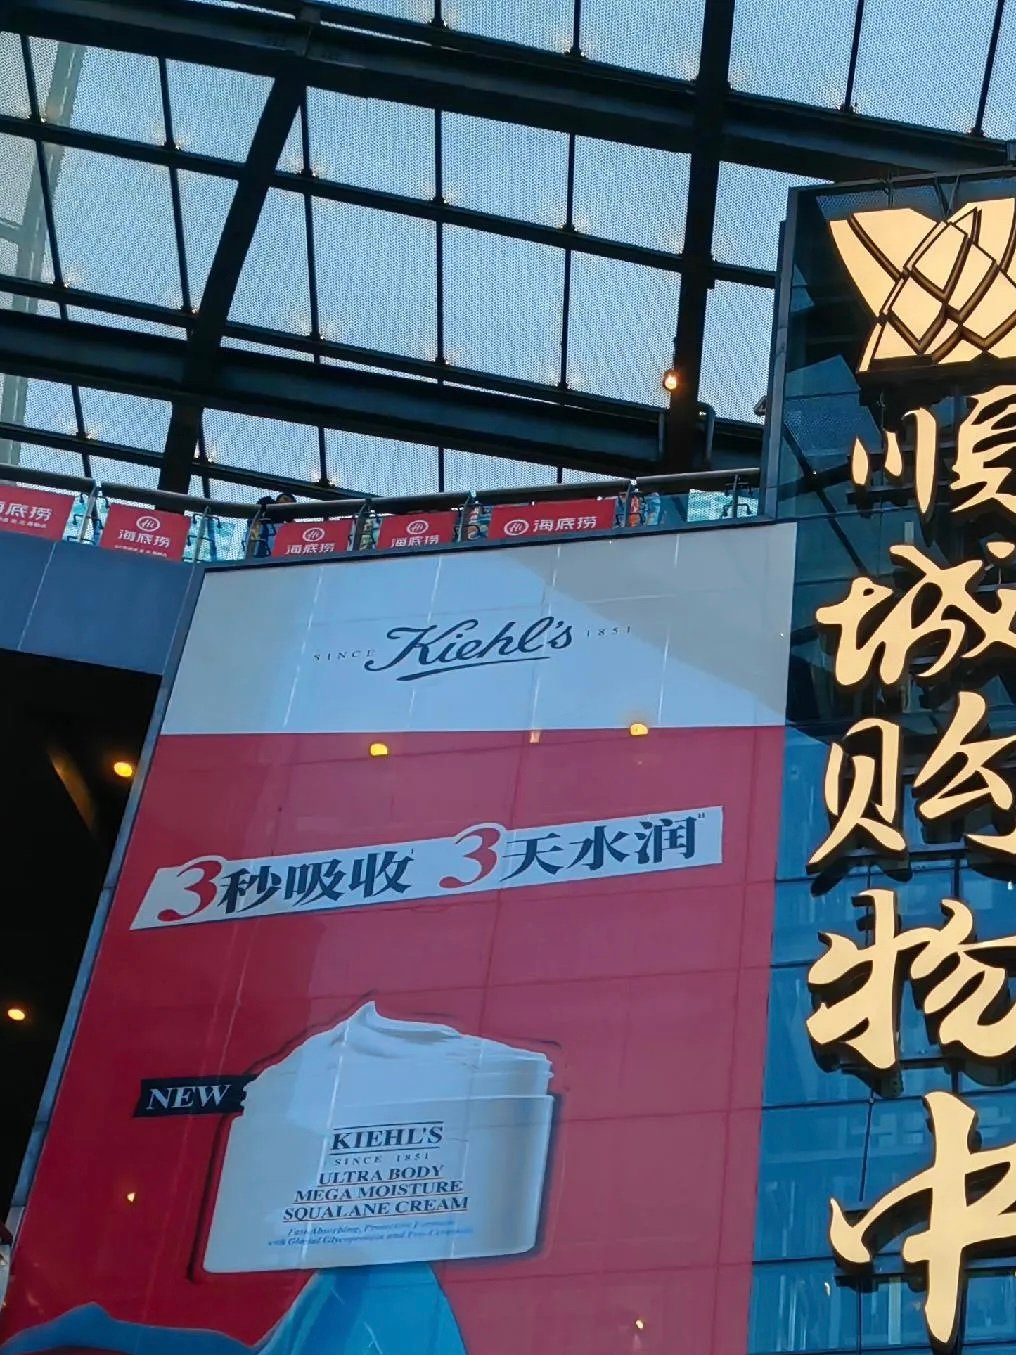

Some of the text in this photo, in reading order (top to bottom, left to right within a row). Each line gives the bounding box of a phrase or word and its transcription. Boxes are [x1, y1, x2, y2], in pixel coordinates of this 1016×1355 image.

[0, 501, 52, 522] 底捞
[533, 516, 597, 532] 海底捞
[117, 529, 170, 549] 海底捞
[284, 542, 336, 555] 海底捞
[391, 534, 440, 548] 海底捞
[313, 649, 377, 662] SINCE
[364, 616, 573, 673] Kiehl's
[145, 1083, 231, 1111] NEW
[330, 1126, 443, 1150] KIEHL'S
[334, 1155, 383, 1166] SINCE
[319, 1165, 445, 1185] ULTRA BODY
[295, 1180, 463, 1202] MEGA MOISTURE
[283, 1197, 469, 1221] SQUALANE CREAM
